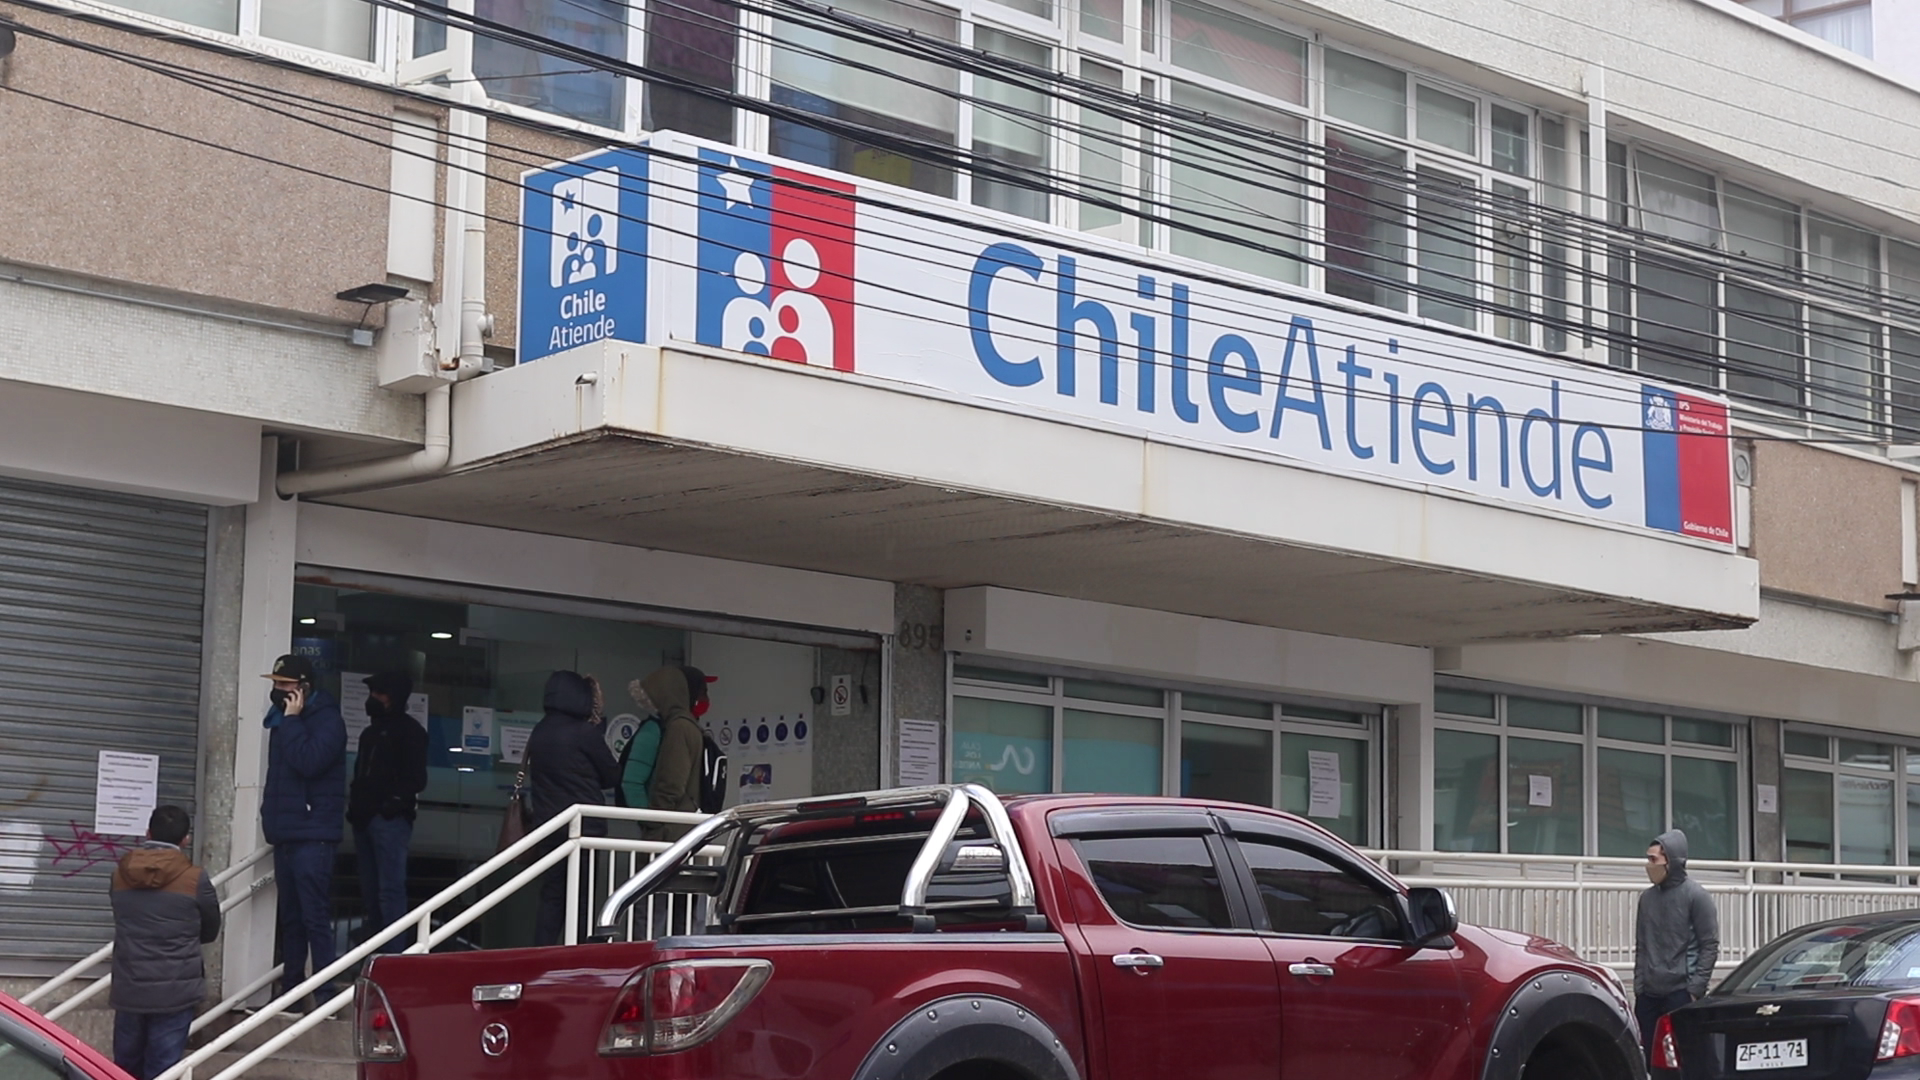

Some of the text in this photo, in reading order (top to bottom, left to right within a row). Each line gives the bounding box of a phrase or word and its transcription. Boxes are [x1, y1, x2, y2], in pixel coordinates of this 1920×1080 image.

[560, 288, 606, 320] Chile
[549, 315, 616, 350] Atiende
[968, 242, 1613, 510] ChileAtiende
[1683, 520, 1729, 538] Gobierno de Chile
[898, 619, 943, 652] 895
